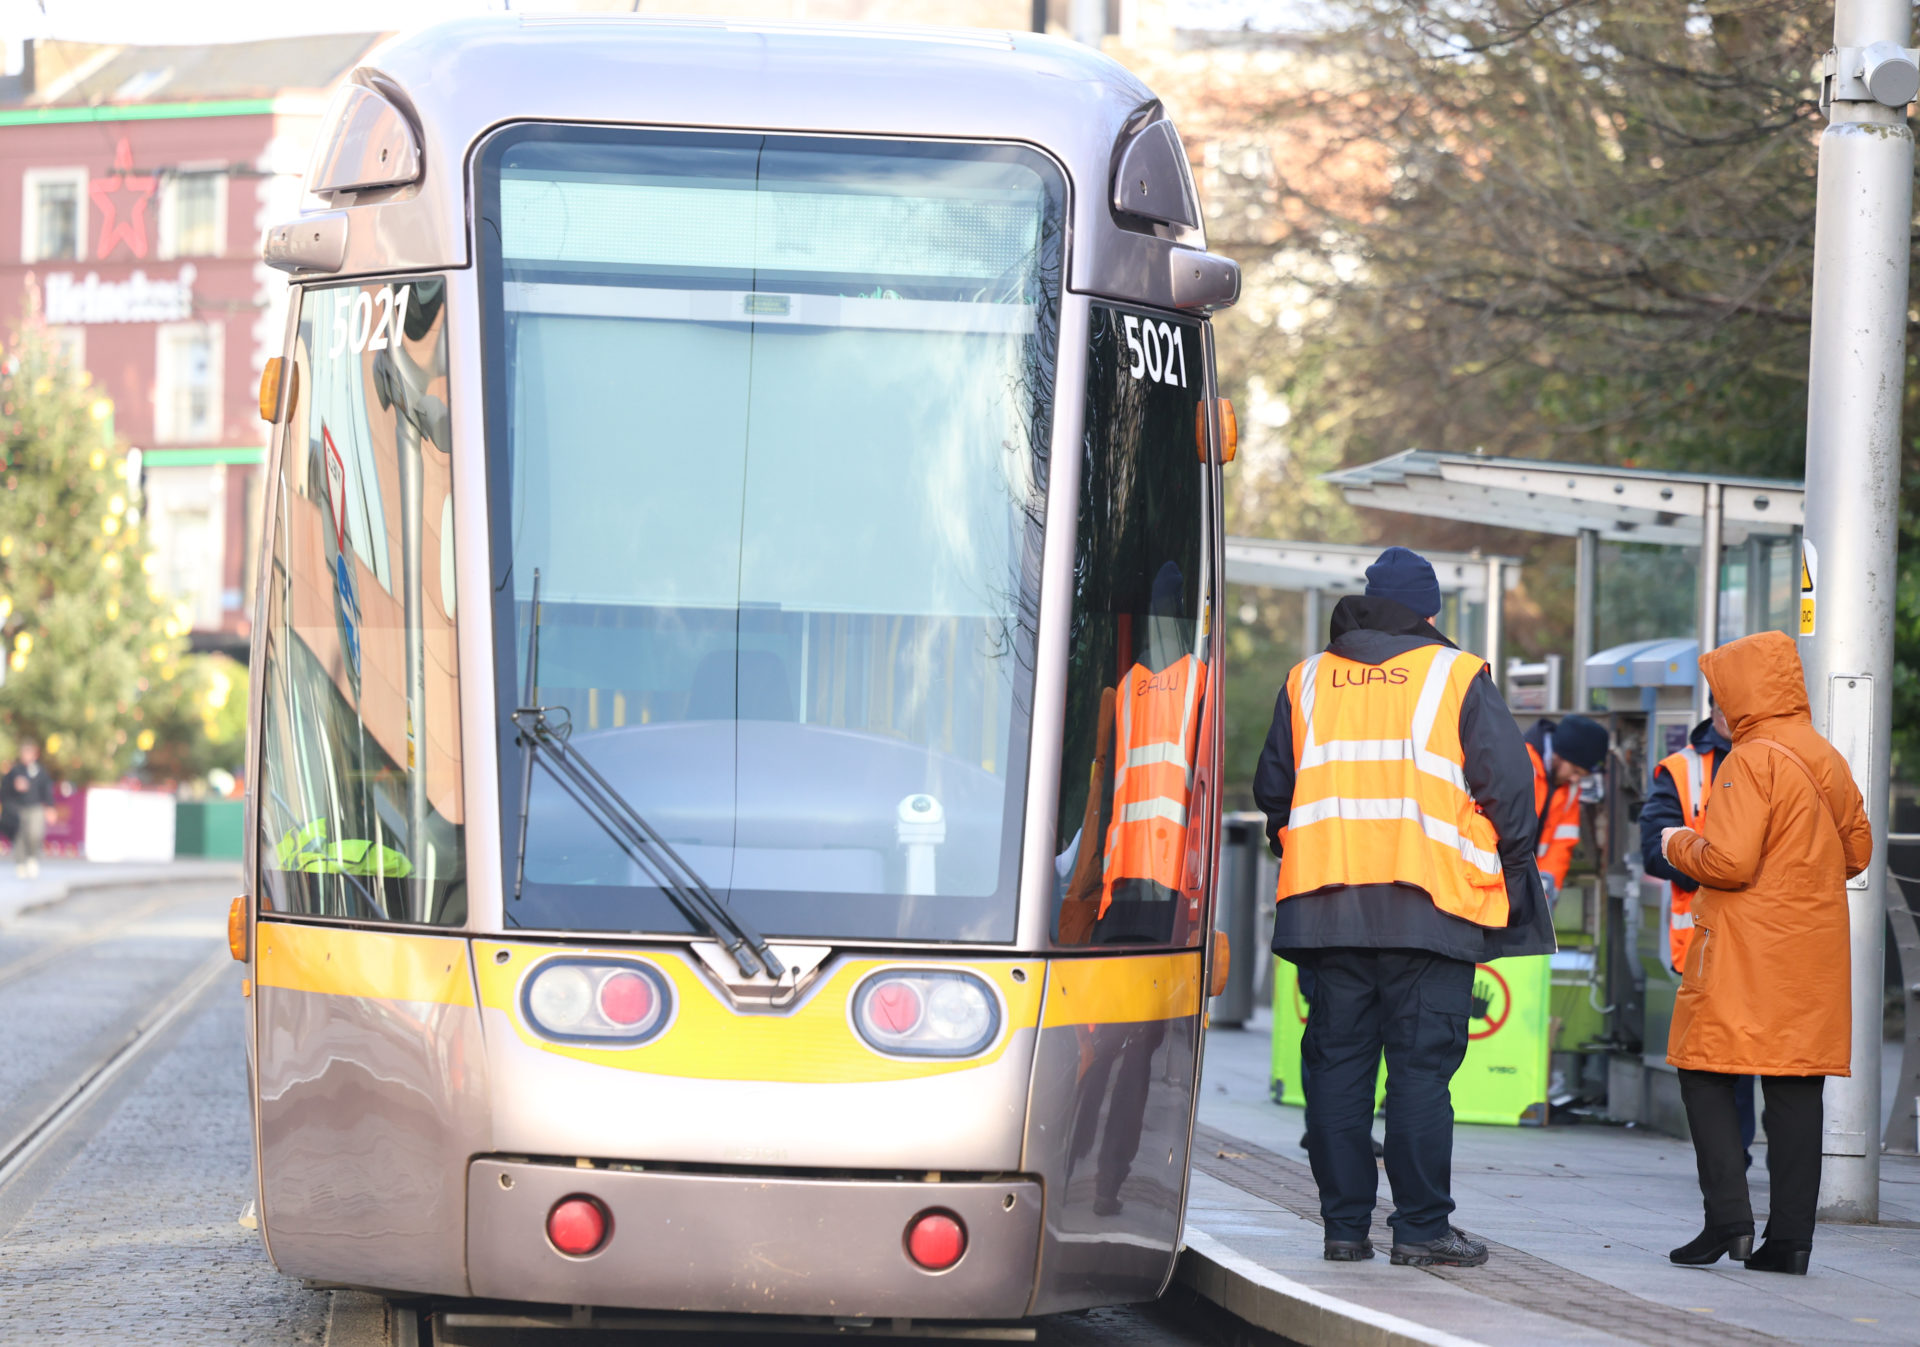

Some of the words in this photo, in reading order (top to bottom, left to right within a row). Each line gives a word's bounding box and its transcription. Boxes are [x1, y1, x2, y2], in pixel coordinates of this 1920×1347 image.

[329, 284, 410, 359] 5021
[1123, 315, 1187, 388] 5021
[1333, 667, 1409, 688] LUAS
